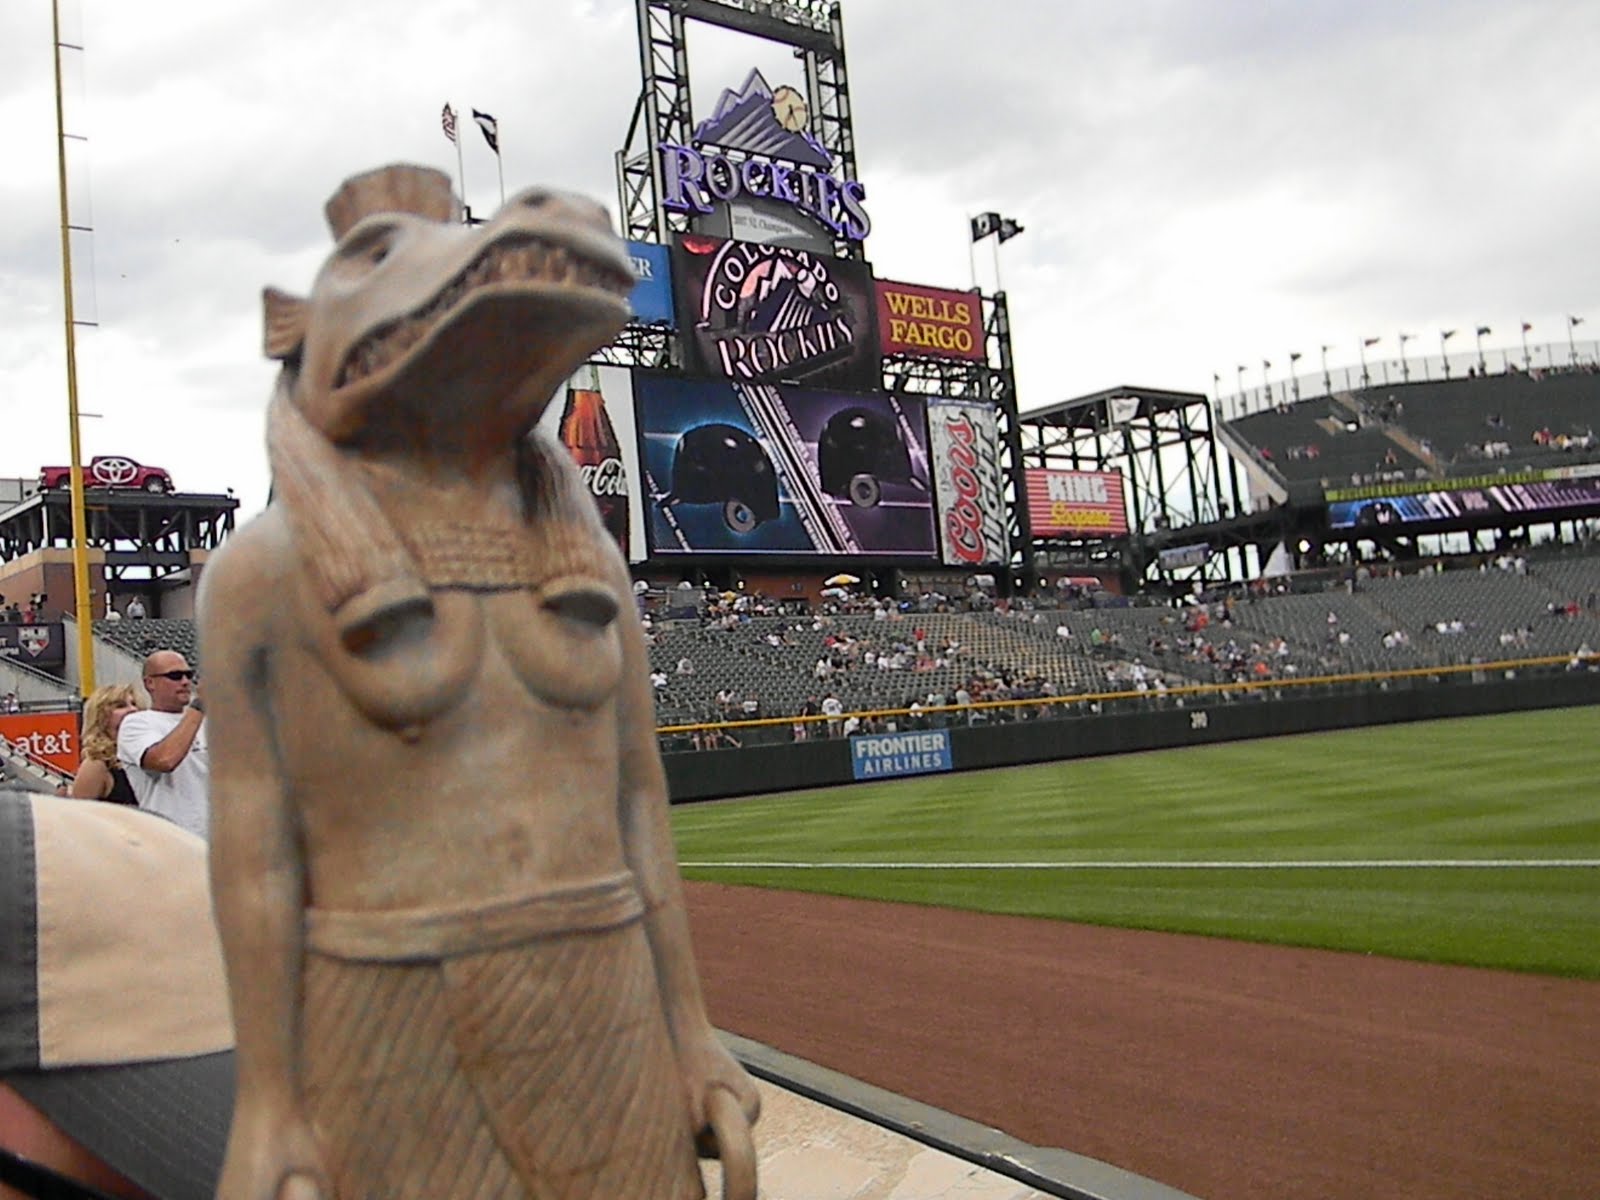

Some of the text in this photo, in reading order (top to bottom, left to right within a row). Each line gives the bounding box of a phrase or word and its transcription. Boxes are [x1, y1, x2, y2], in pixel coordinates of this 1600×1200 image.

[658, 142, 871, 240] ROCKIES
[884, 292, 971, 325] WELLS
[889, 318, 973, 352] FARGO
[946, 411, 987, 563] Coors
[1046, 474, 1108, 503] KING
[16, 729, 72, 756] at&t
[855, 733, 945, 758] FRONTIER
[864, 752, 943, 775] AIRLINES
